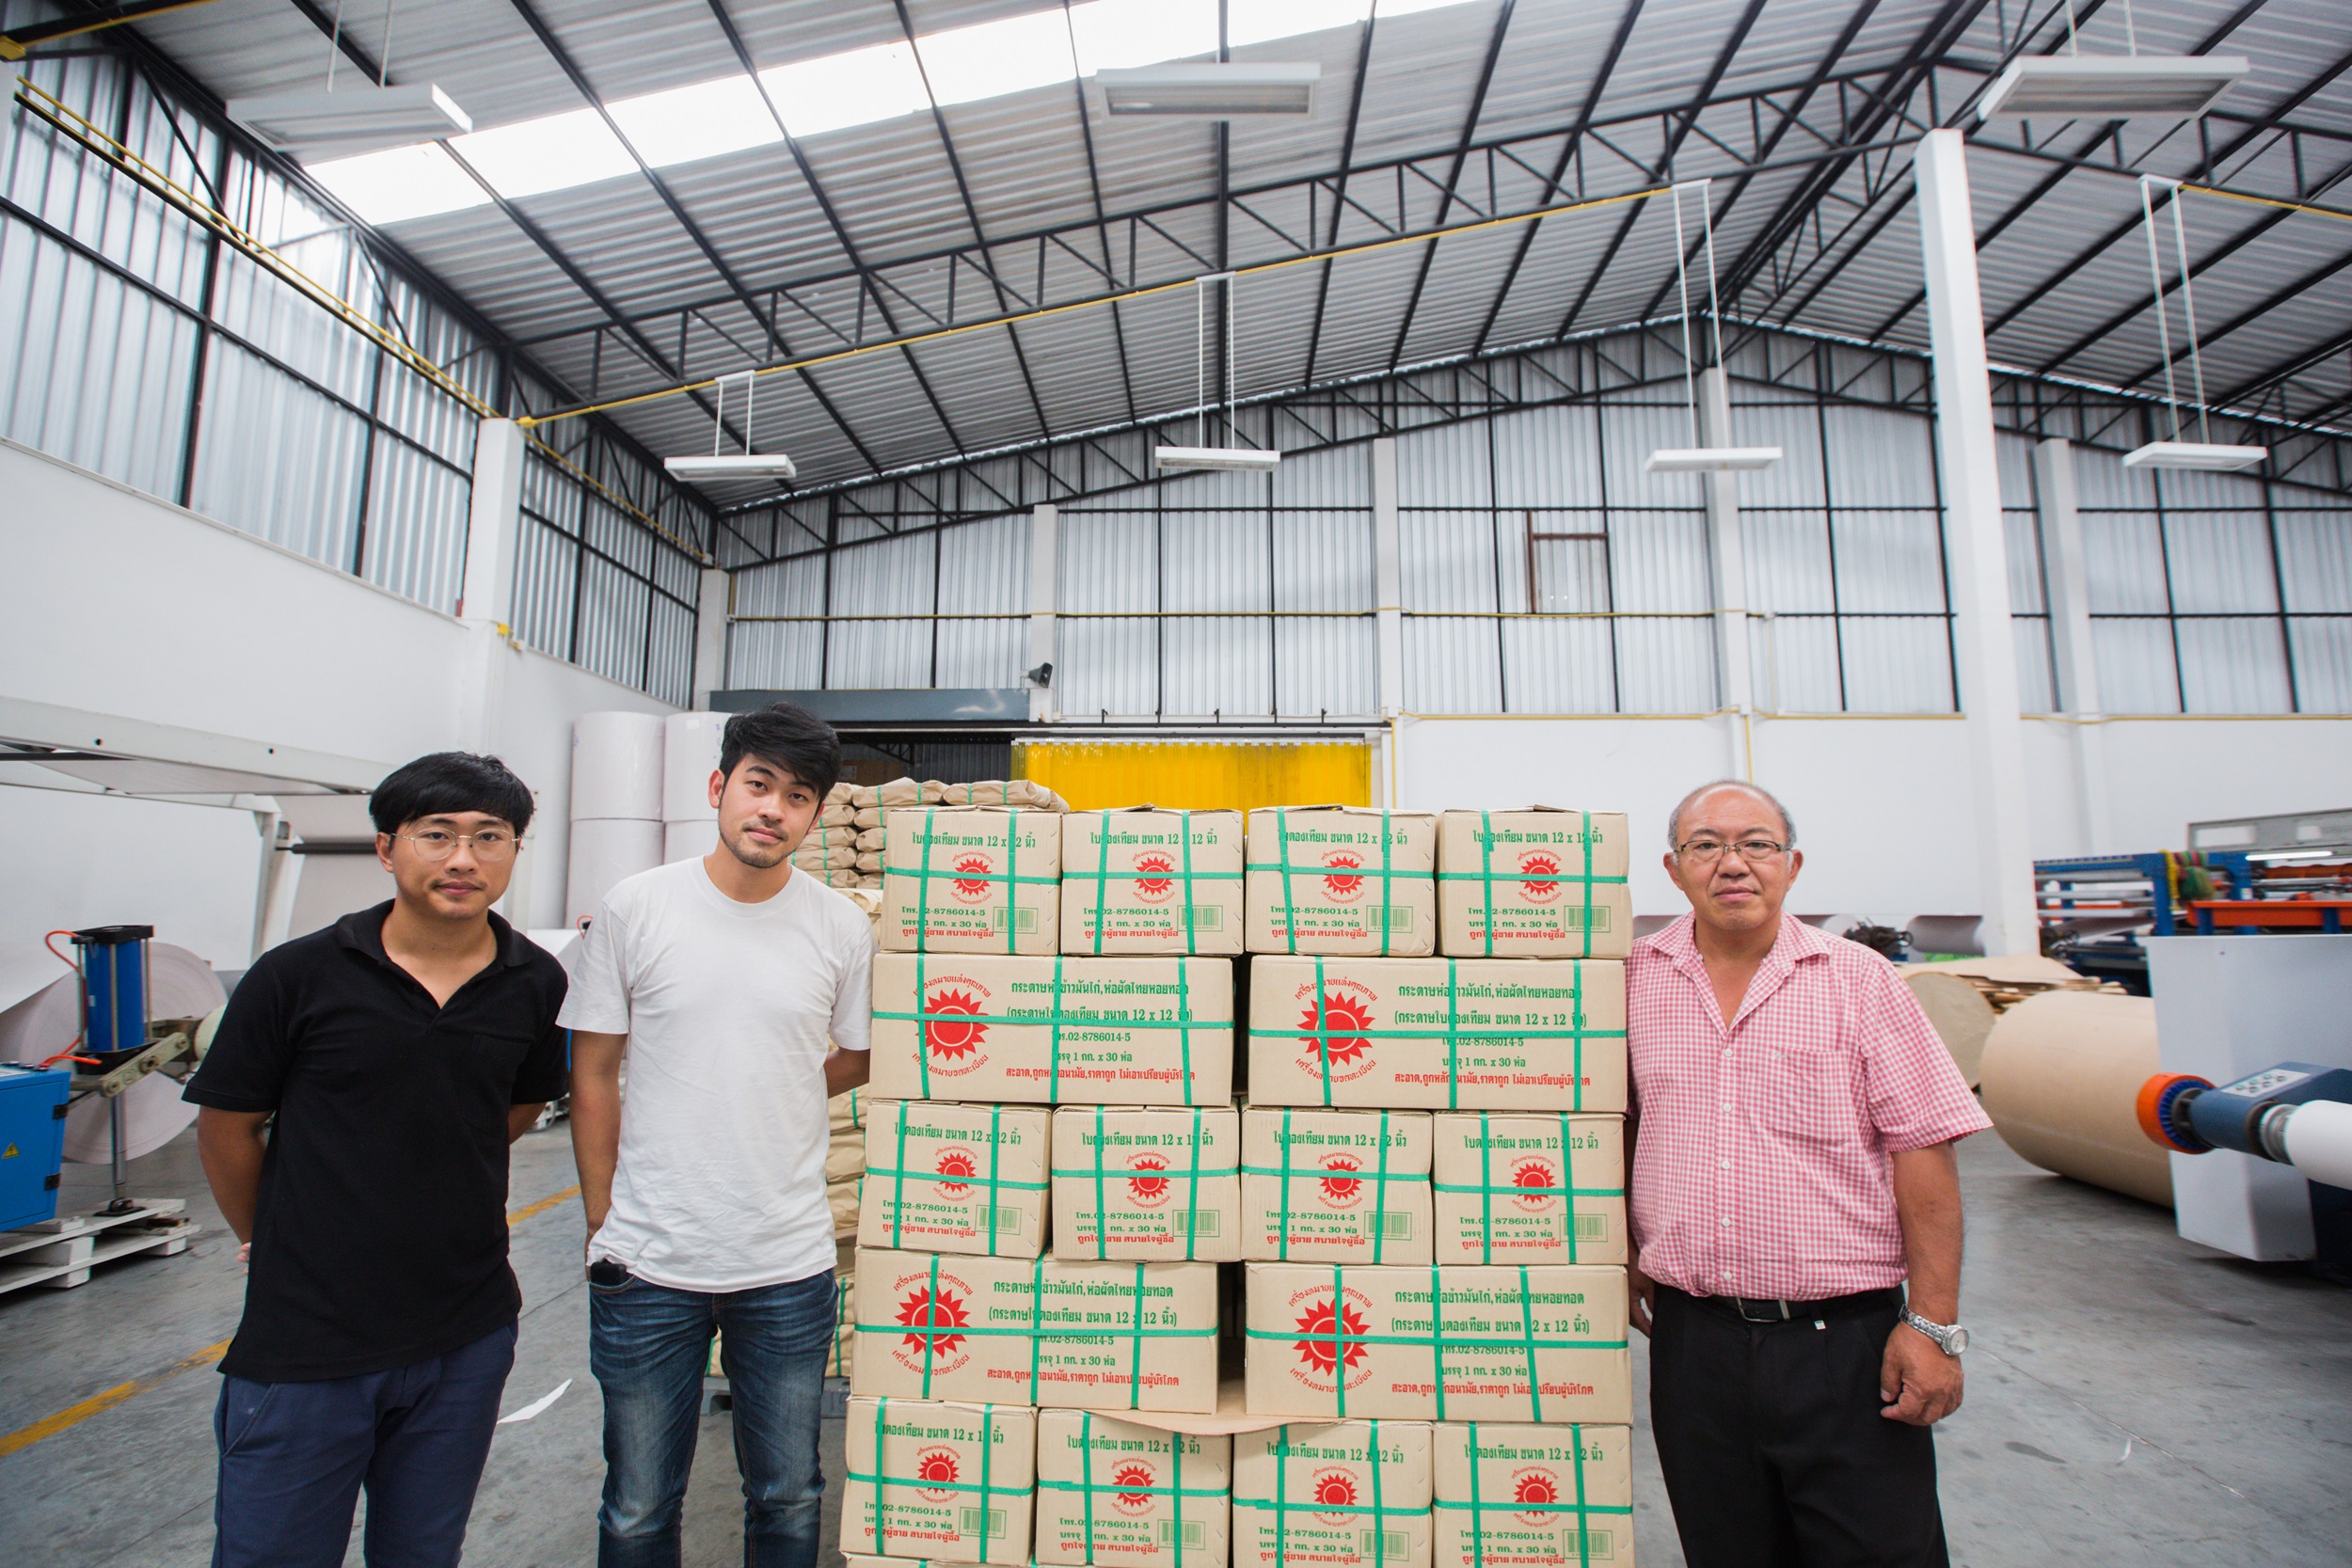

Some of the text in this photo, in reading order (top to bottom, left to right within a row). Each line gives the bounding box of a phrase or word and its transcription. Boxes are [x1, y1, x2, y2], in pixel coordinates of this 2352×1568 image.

[961, 836, 983, 847] ขนาด
[987, 835, 998, 847] 12
[1001, 838, 1007, 847] x
[1025, 832, 1036, 848] นิ้ว
[1141, 833, 1164, 845] ขนาด
[1168, 833, 1179, 845] 12
[1191, 833, 1203, 845] 12
[1206, 828, 1217, 846] นิ้ว
[1330, 832, 1353, 844] ขนาด
[1357, 832, 1369, 844] 12
[1372, 835, 1377, 844] x
[1396, 828, 1408, 846] นิ้ว
[1526, 832, 1549, 844] ขนาด
[1552, 832, 1564, 844] 12
[1566, 834, 1573, 844] x
[1592, 826, 1603, 844] นิ้ว
[901, 906, 986, 916] โทร.2-8786014-5
[1468, 908, 1556, 916] โทร.2-8786014-5
[946, 927, 994, 939] สบายใจผู้ซื้อ
[1129, 927, 1179, 939] สบายใจผู้ซื้อ
[1317, 927, 1368, 940] สบายใจผู้ซื้อ
[1516, 927, 1565, 941] สบายใจผู้ซื้อ
[1104, 1010, 1128, 1021] ขนาด
[1133, 1009, 1145, 1021] 12
[1149, 1011, 1156, 1021] x
[1160, 1008, 1172, 1022] 12
[1394, 1010, 1491, 1025] (กระดาษใบองเทียม
[1495, 1013, 1521, 1025] ขนาด
[1525, 1013, 1538, 1025] 12
[1542, 1014, 1549, 1025] x
[1553, 1013, 1566, 1026] 12
[1053, 1053, 1072, 1064] รรจุ
[1073, 1053, 1078, 1061] 1
[1081, 1053, 1095, 1062] กก.
[1105, 1053, 1118, 1062] 30
[1120, 1051, 1133, 1062] ห่อ
[1465, 1056, 1470, 1067] 1
[1473, 1057, 1487, 1067] กก.
[1490, 1058, 1497, 1067] x
[1499, 1057, 1512, 1067] 30
[1514, 1055, 1526, 1068] ห่อ
[1119, 1068, 1195, 1084] ไม่เอาเปรียบผู้บริโค
[1394, 1070, 1509, 1088] สะอาด,ถูกหลักนามัย,ราคาถูก
[894, 1121, 1022, 1145] ใตองเทียม ขนาด 12 x นิ้ว
[1135, 1134, 1158, 1146] ขนาด
[1162, 1134, 1173, 1146] 12
[1177, 1136, 1183, 1146] x
[1202, 1128, 1214, 1146] นิ้ว
[1327, 1133, 1351, 1146] ขนาด
[1355, 1134, 1367, 1147] 12
[1370, 1137, 1376, 1147] x
[1395, 1129, 1406, 1148] นิ้ว
[1463, 1131, 1598, 1149] ใบตงเทียม ขนาด 12 12 นิ้ว
[1459, 1216, 1551, 1226] โทร.0-8786014-5
[927, 1224, 977, 1238] สบายใจผู้ซื้อ
[1123, 1232, 1174, 1245] สบายใจผู้ซื้อ
[1313, 1234, 1365, 1247] สบายใจผู้ซื้อ
[1509, 1237, 1561, 1249] สบายใจผู้ซื้อ
[1086, 1312, 1112, 1323] ขนาด
[1116, 1312, 1129, 1324] 12
[1143, 1312, 1157, 1324] 12
[1162, 1306, 1178, 1327] นิ้ว)
[1391, 1313, 1590, 1335] (กระดาษบตองเทียม ขนาด x 12 นิ้ว)
[1038, 1354, 1053, 1367] รรจุ
[1056, 1355, 1060, 1364] 1
[1063, 1356, 1077, 1365] กก.
[1089, 1355, 1101, 1366] 30
[1104, 1354, 1116, 1367] ห่อ
[1465, 1366, 1470, 1375] 1
[1473, 1367, 1487, 1376] กก.
[1499, 1366, 1512, 1376] 30
[1515, 1364, 1527, 1377] ห่อ
[927, 1427, 949, 1439] ขนาด
[953, 1428, 964, 1440] 12
[967, 1432, 974, 1441] x
[993, 1425, 1004, 1444] นิ้ว
[1120, 1440, 1144, 1451] ขนาด
[1148, 1440, 1160, 1452] 12
[1163, 1443, 1169, 1453] x
[1189, 1436, 1200, 1454] นิ้ว
[1464, 1442, 1603, 1462] ใตองเทียม ขนาด 12 x นิ้ว
[1322, 1448, 1345, 1460] ขนาด
[1350, 1449, 1362, 1461] 12
[1391, 1444, 1405, 1464] นิ้ว
[910, 1529, 960, 1543] สบายใจผู้ซื้อ
[1259, 1527, 1352, 1539] โทร.2-8786014-5
[1107, 1542, 1159, 1555] สบายใจผู้ซื้อ
[1309, 1552, 1361, 1565] สบายใจผู้ซื้อ
[1512, 1553, 1565, 1565] สบายใจผู้ซื้อ
